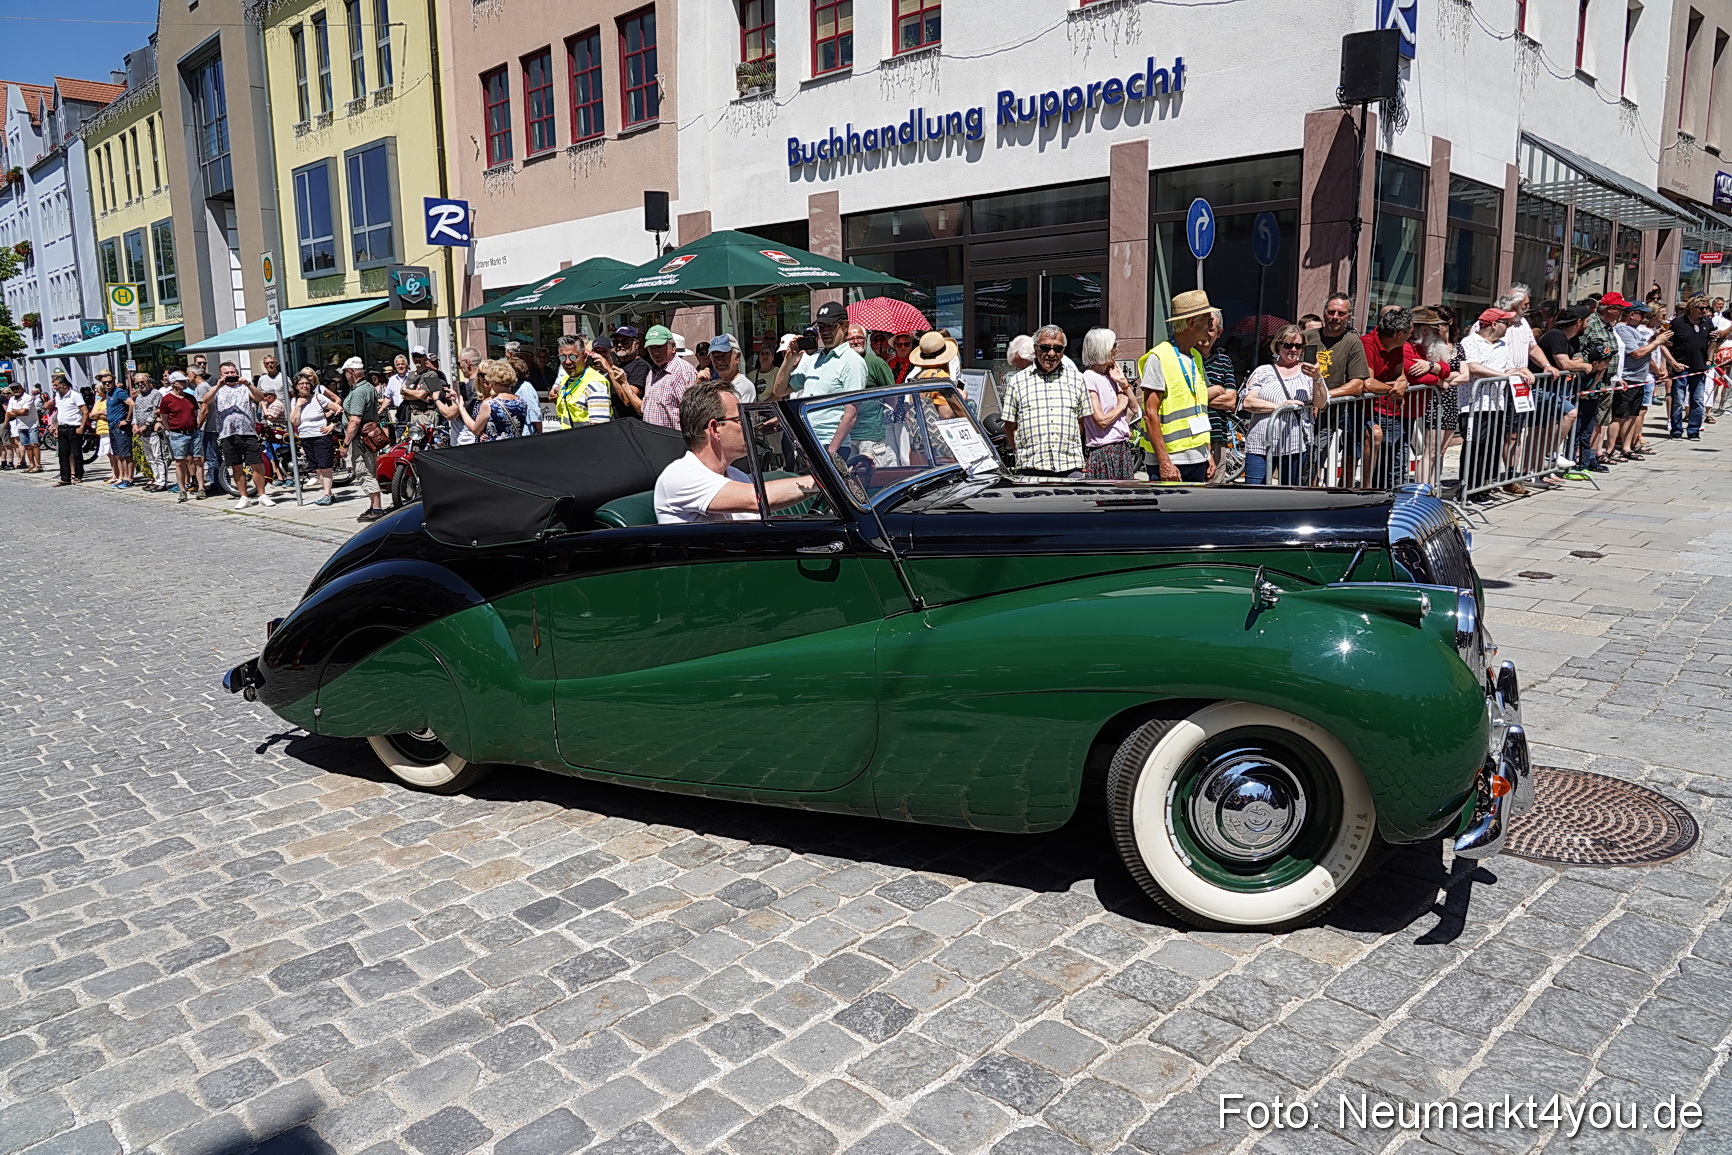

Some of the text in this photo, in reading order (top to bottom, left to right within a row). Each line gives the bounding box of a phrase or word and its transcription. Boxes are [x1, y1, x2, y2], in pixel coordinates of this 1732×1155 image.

[787, 55, 1187, 167] Buchhandlung Rupprecht
[489, 257, 502, 267] Markt
[405, 277, 422, 297] G2
[958, 428, 972, 441] 497
